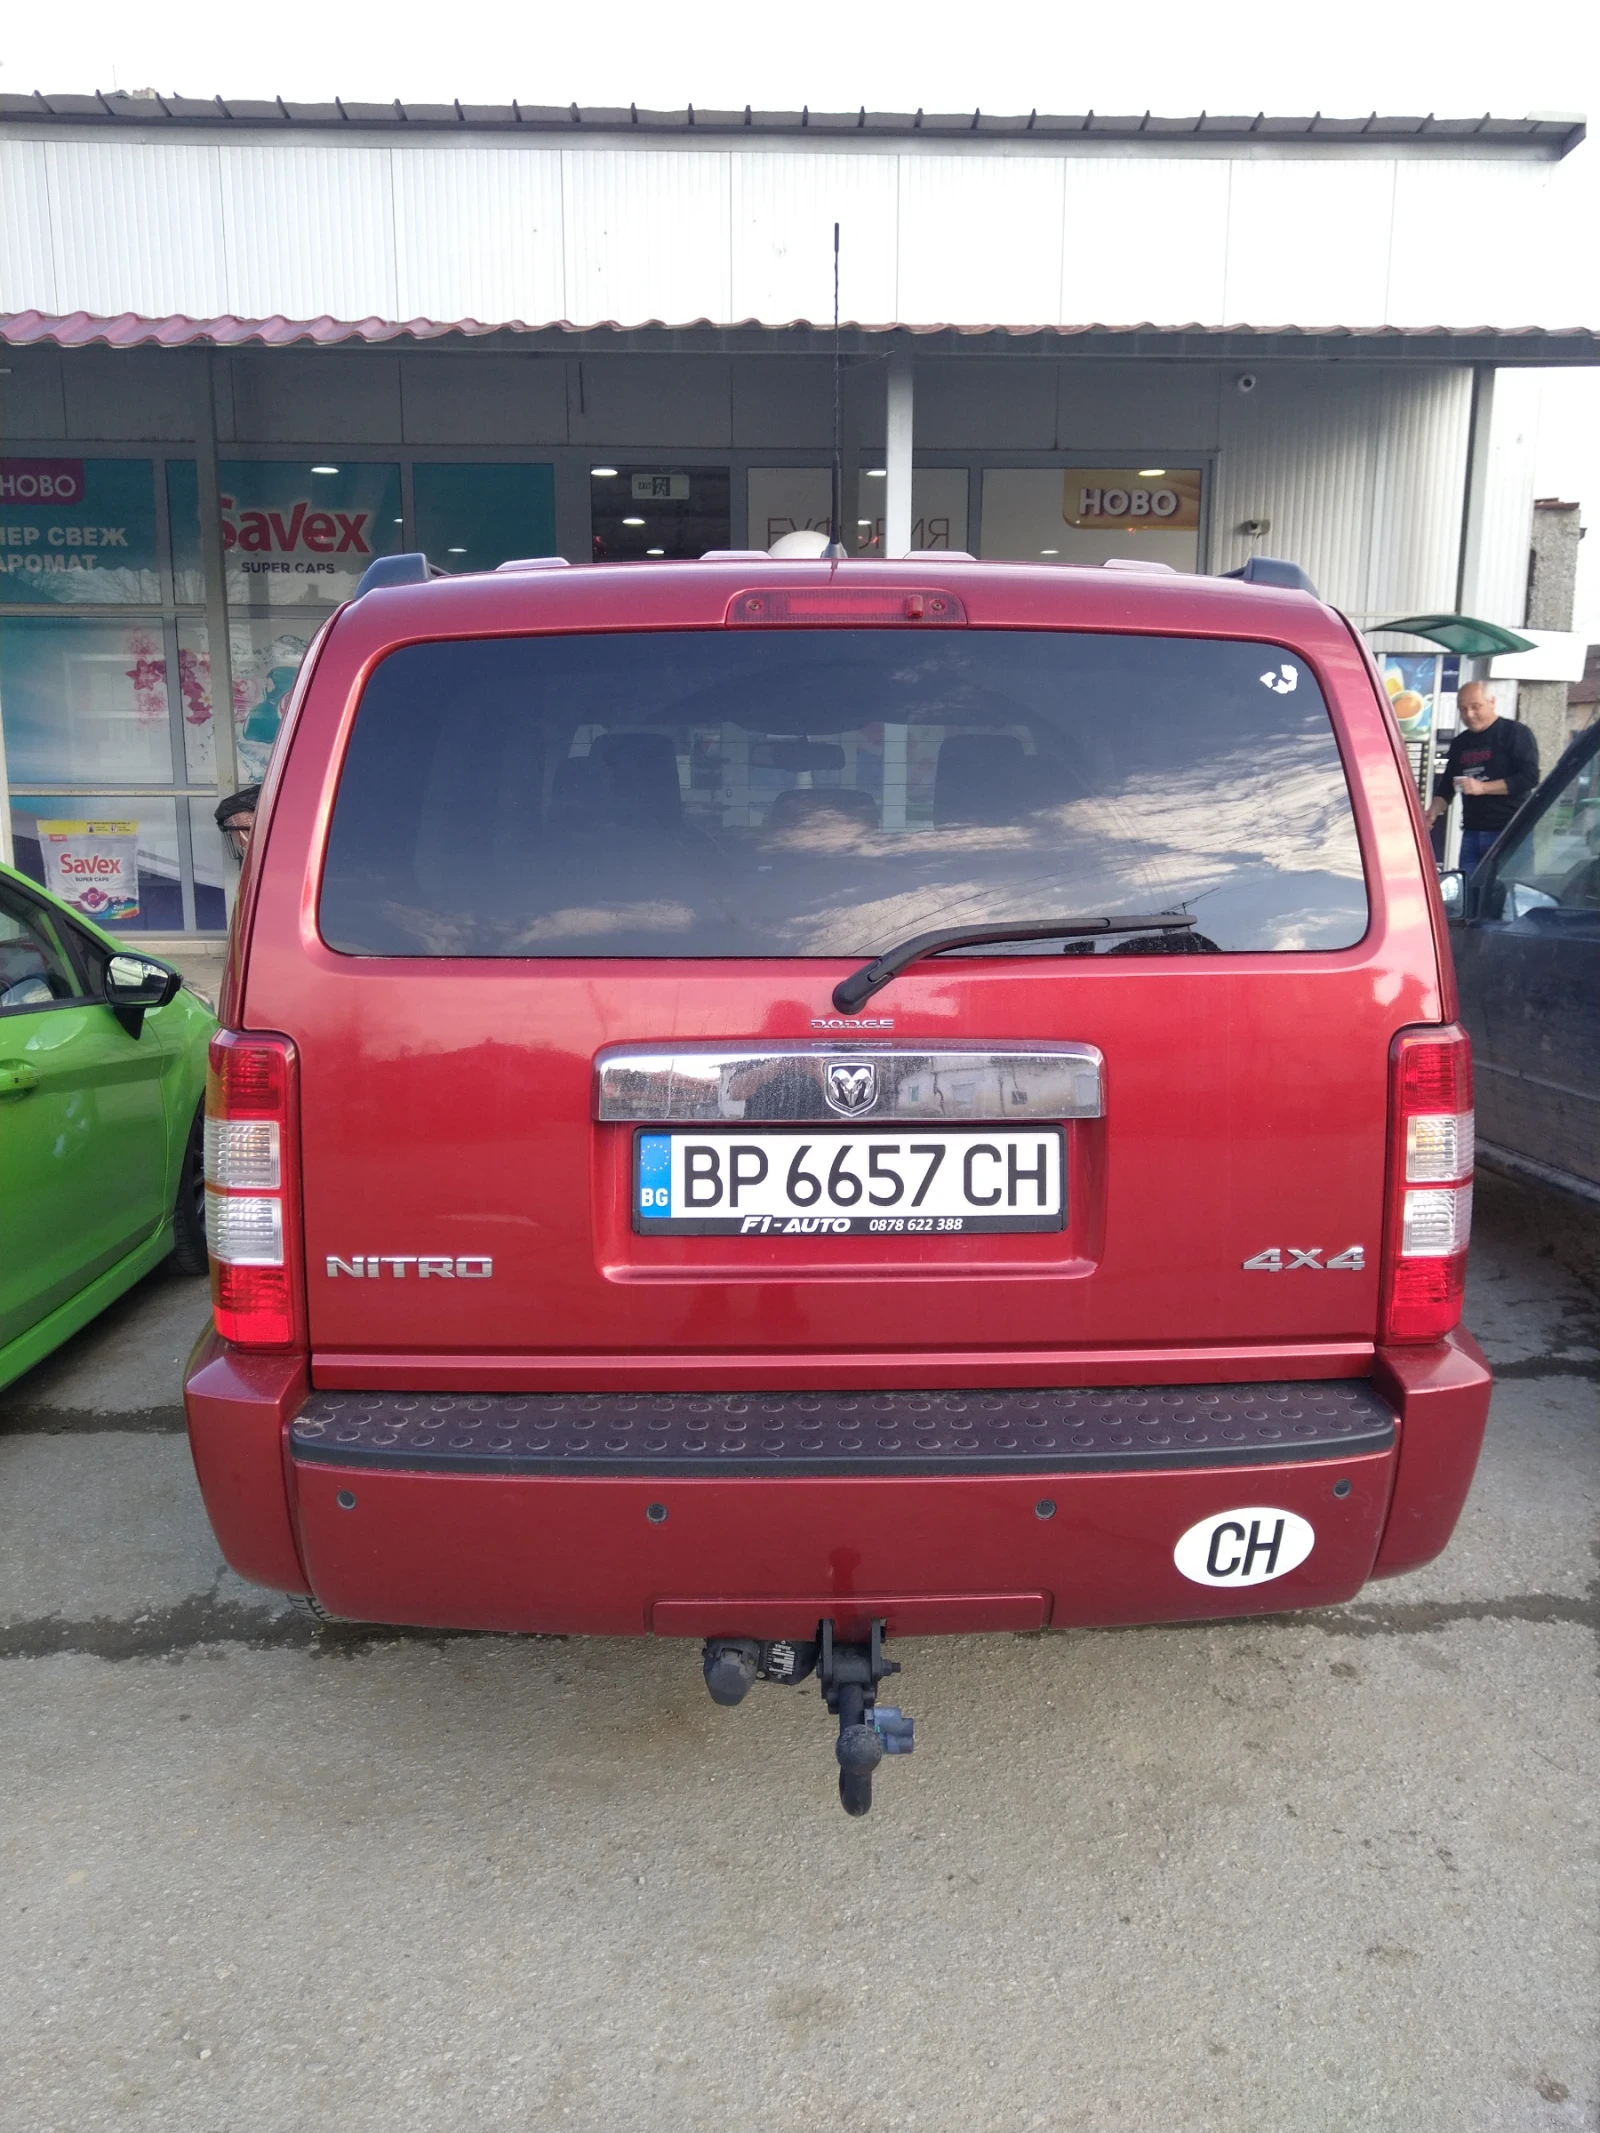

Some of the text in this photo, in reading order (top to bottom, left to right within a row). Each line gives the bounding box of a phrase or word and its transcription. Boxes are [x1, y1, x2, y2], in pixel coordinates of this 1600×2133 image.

[0, 474, 77, 497] НОВО
[638, 482, 652, 490] EXIT
[1079, 487, 1178, 517] НОВО
[47, 527, 128, 546] СВЕЖ
[241, 562, 336, 574] SUPER CAPS
[60, 853, 121, 873] Savex
[811, 1019, 894, 1029] DODGE
[786, 1144, 946, 1208] 6657
[641, 1188, 669, 1207] BG
[740, 1217, 964, 1233] F1-AUTO 0878 622 388
[326, 1256, 493, 1278] NITRO
[1206, 1518, 1286, 1578] CH
